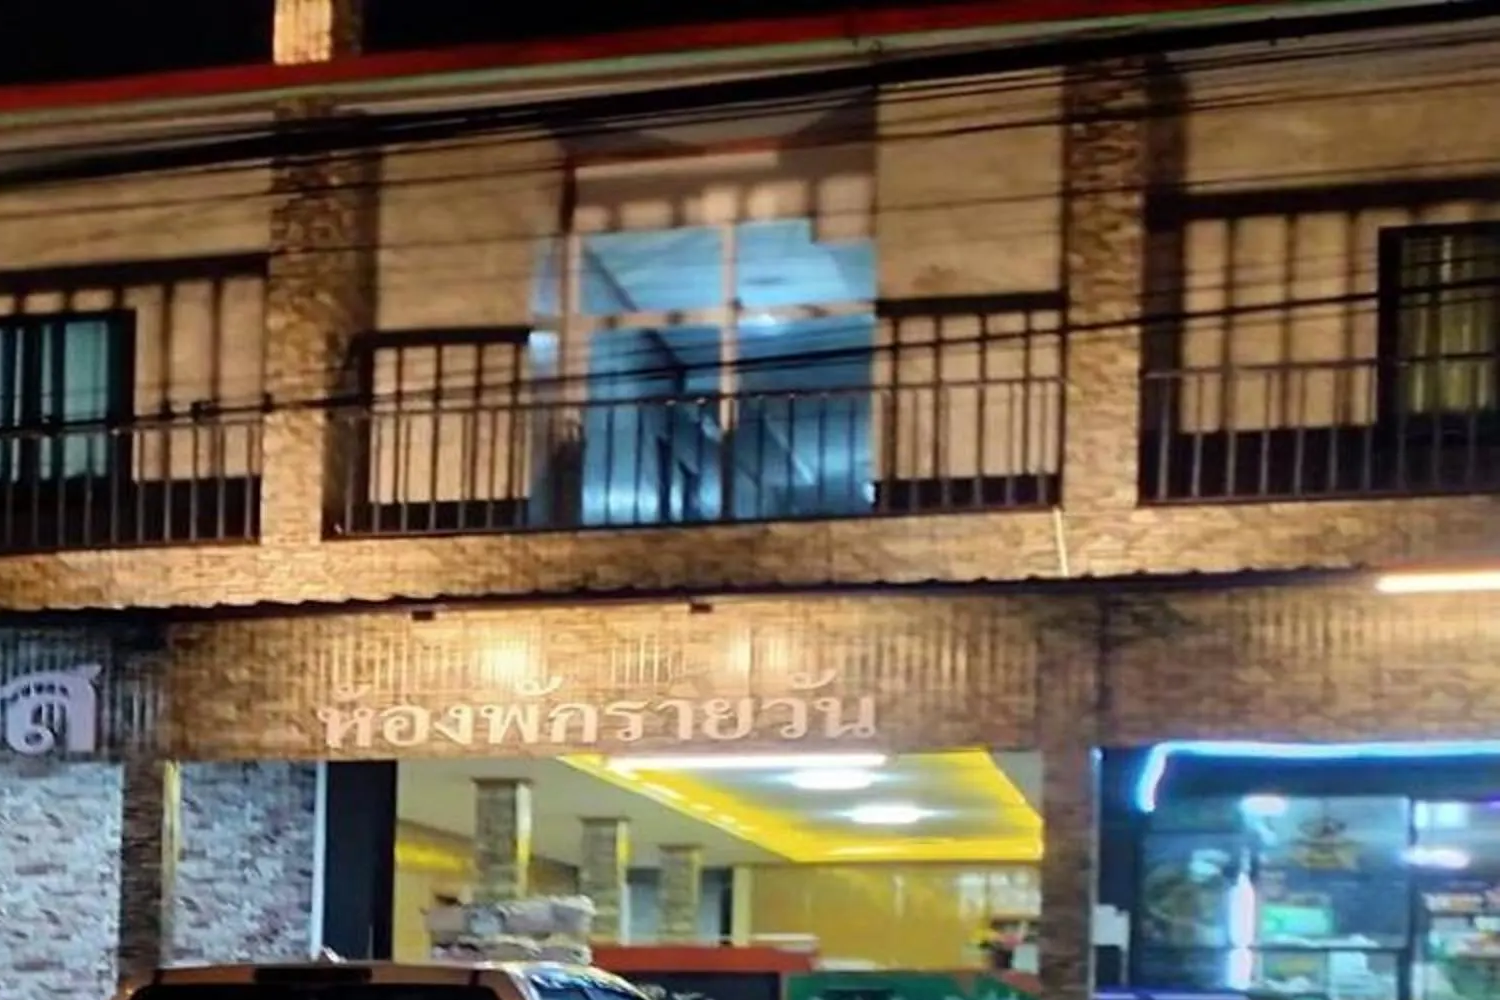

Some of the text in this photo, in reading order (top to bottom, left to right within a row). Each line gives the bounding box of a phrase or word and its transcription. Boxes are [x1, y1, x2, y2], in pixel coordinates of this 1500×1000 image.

[318, 669, 876, 749] ห้องพักรายวัน
